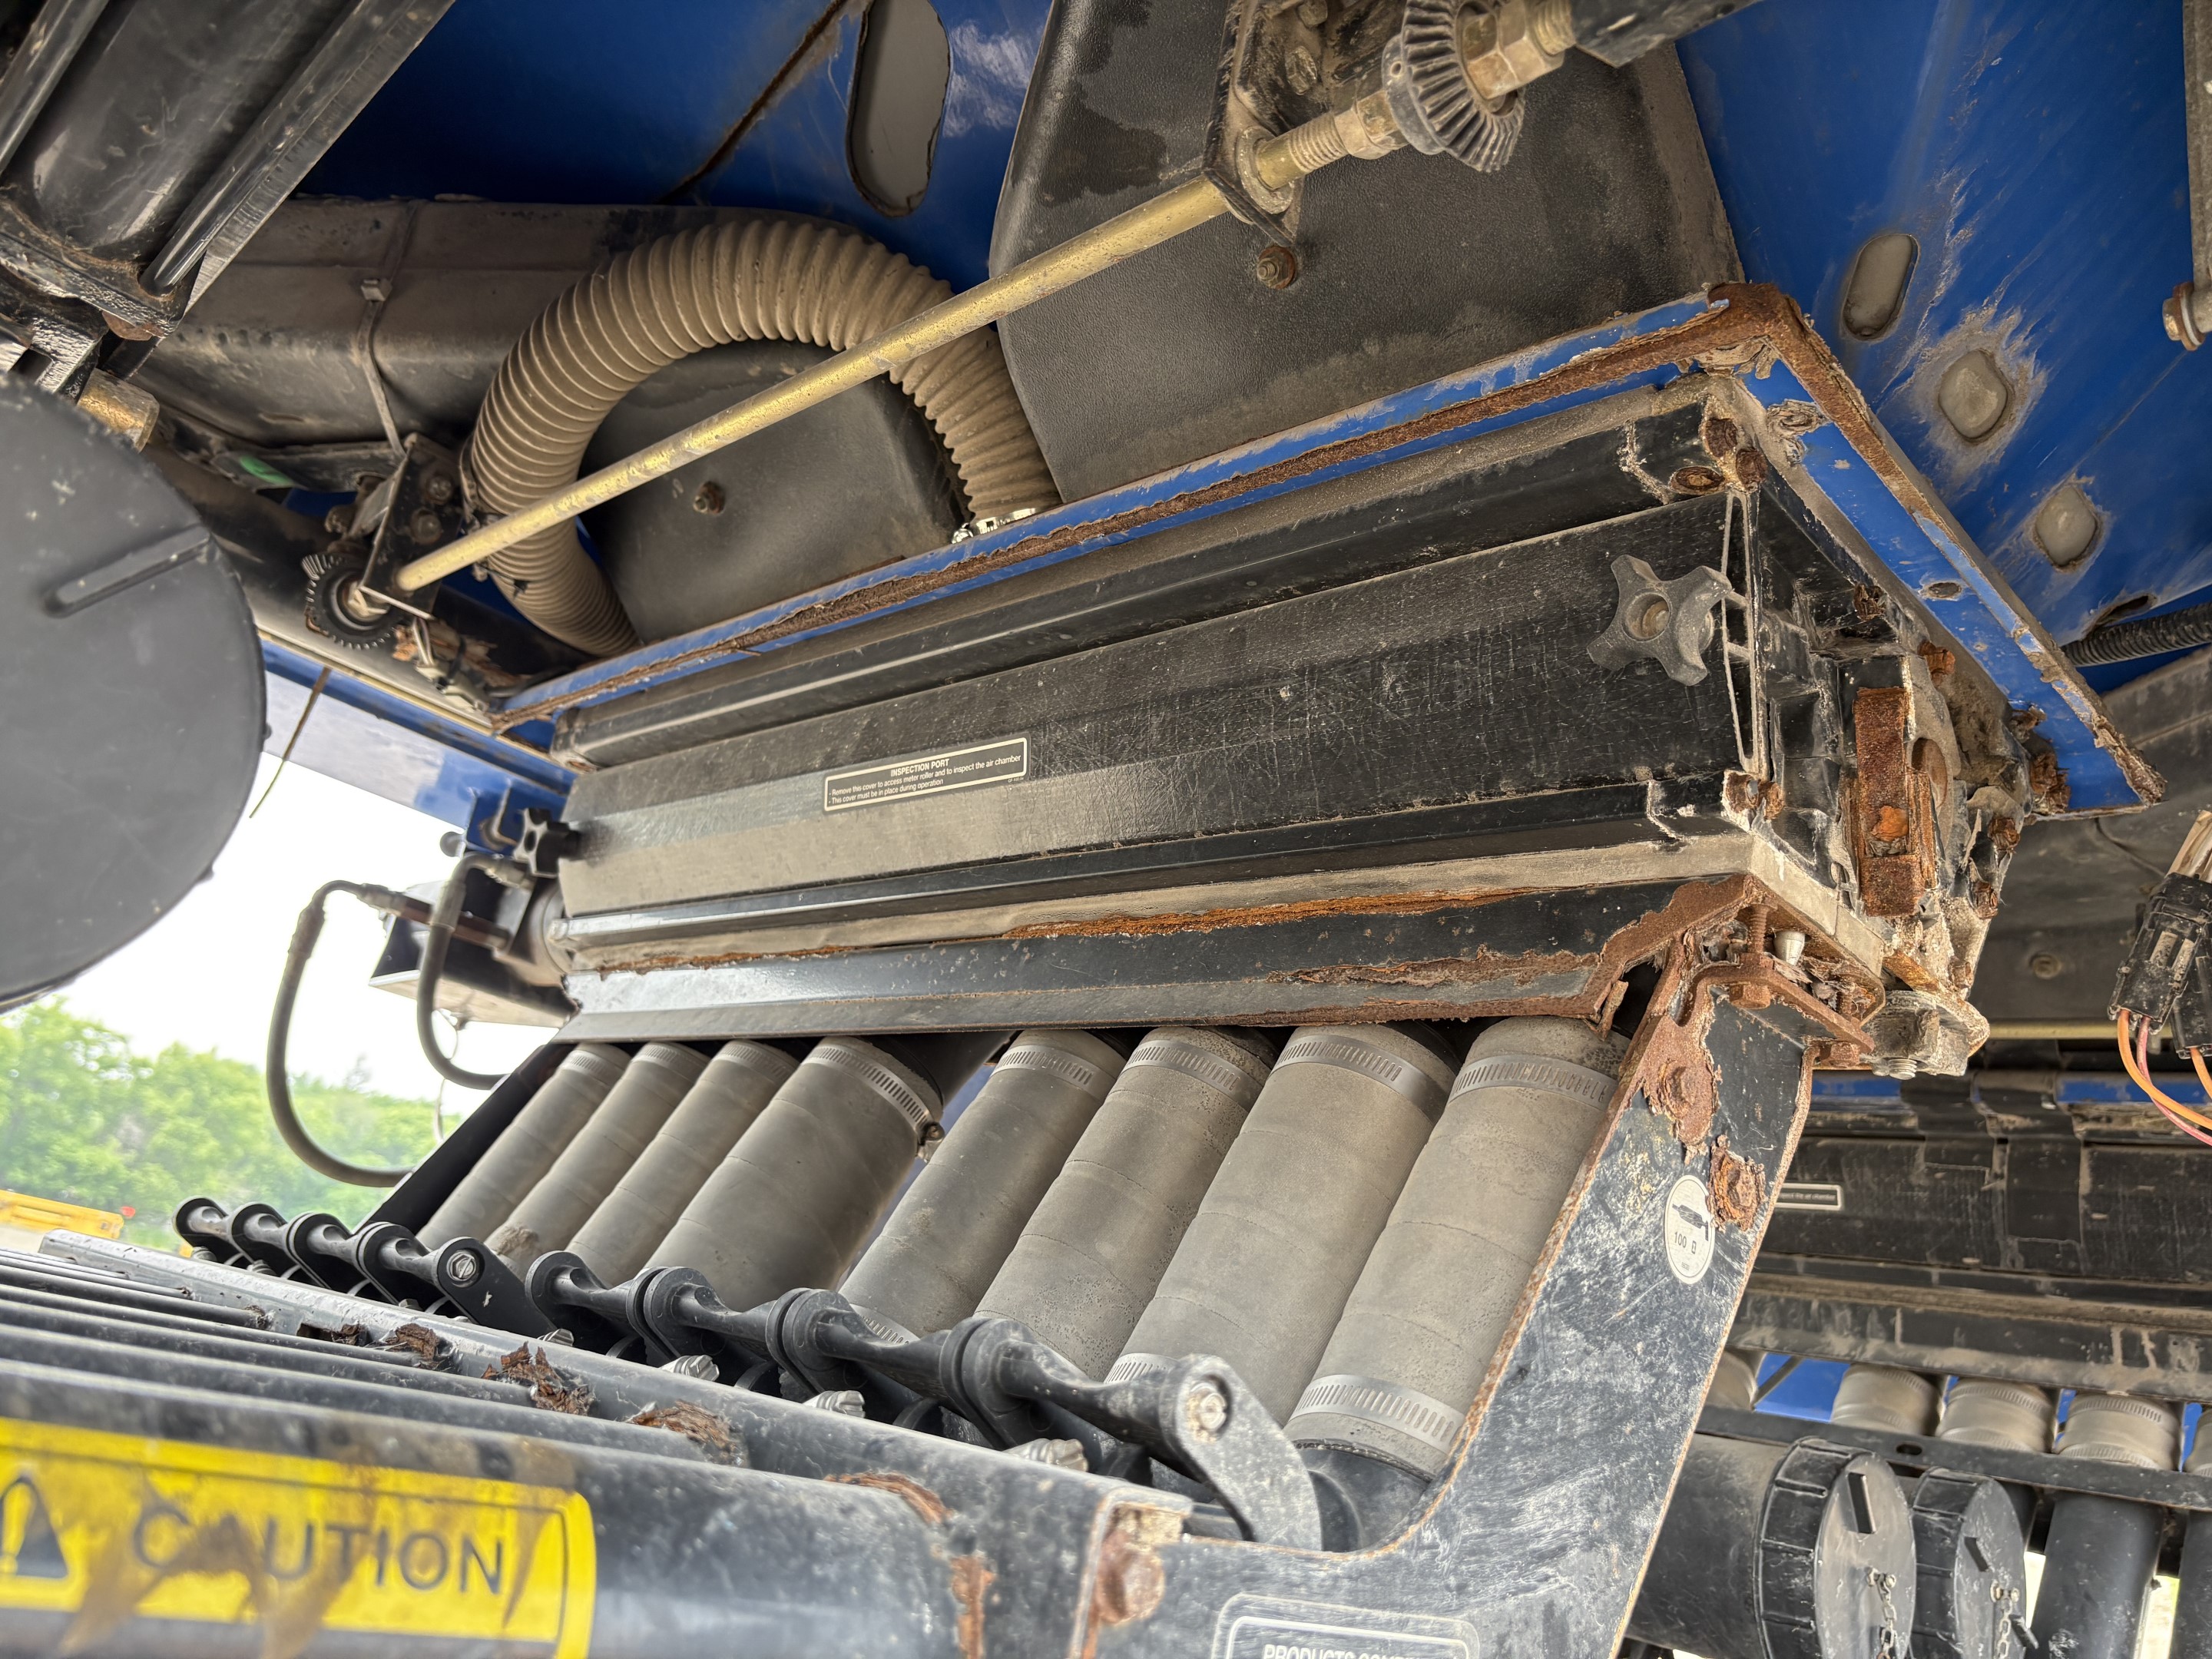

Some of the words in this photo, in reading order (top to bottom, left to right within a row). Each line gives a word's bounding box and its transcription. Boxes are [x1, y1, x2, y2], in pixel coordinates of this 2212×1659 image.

[832, 787, 852, 796] Remove
[863, 783, 877, 791] cover
[884, 778, 902, 786] access
[919, 771, 934, 780] roller
[934, 769, 945, 777] and
[953, 764, 975, 774] inspect
[985, 759, 994, 767] air
[995, 755, 1022, 766] chamber
[891, 761, 930, 777] INSPECTION
[931, 758, 949, 769] PORT
[843, 794, 856, 803] cover
[857, 791, 870, 800] must
[884, 786, 899, 796] place
[899, 783, 917, 792] during
[917, 778, 944, 790] operation
[1674, 1231, 1687, 1248] 100
